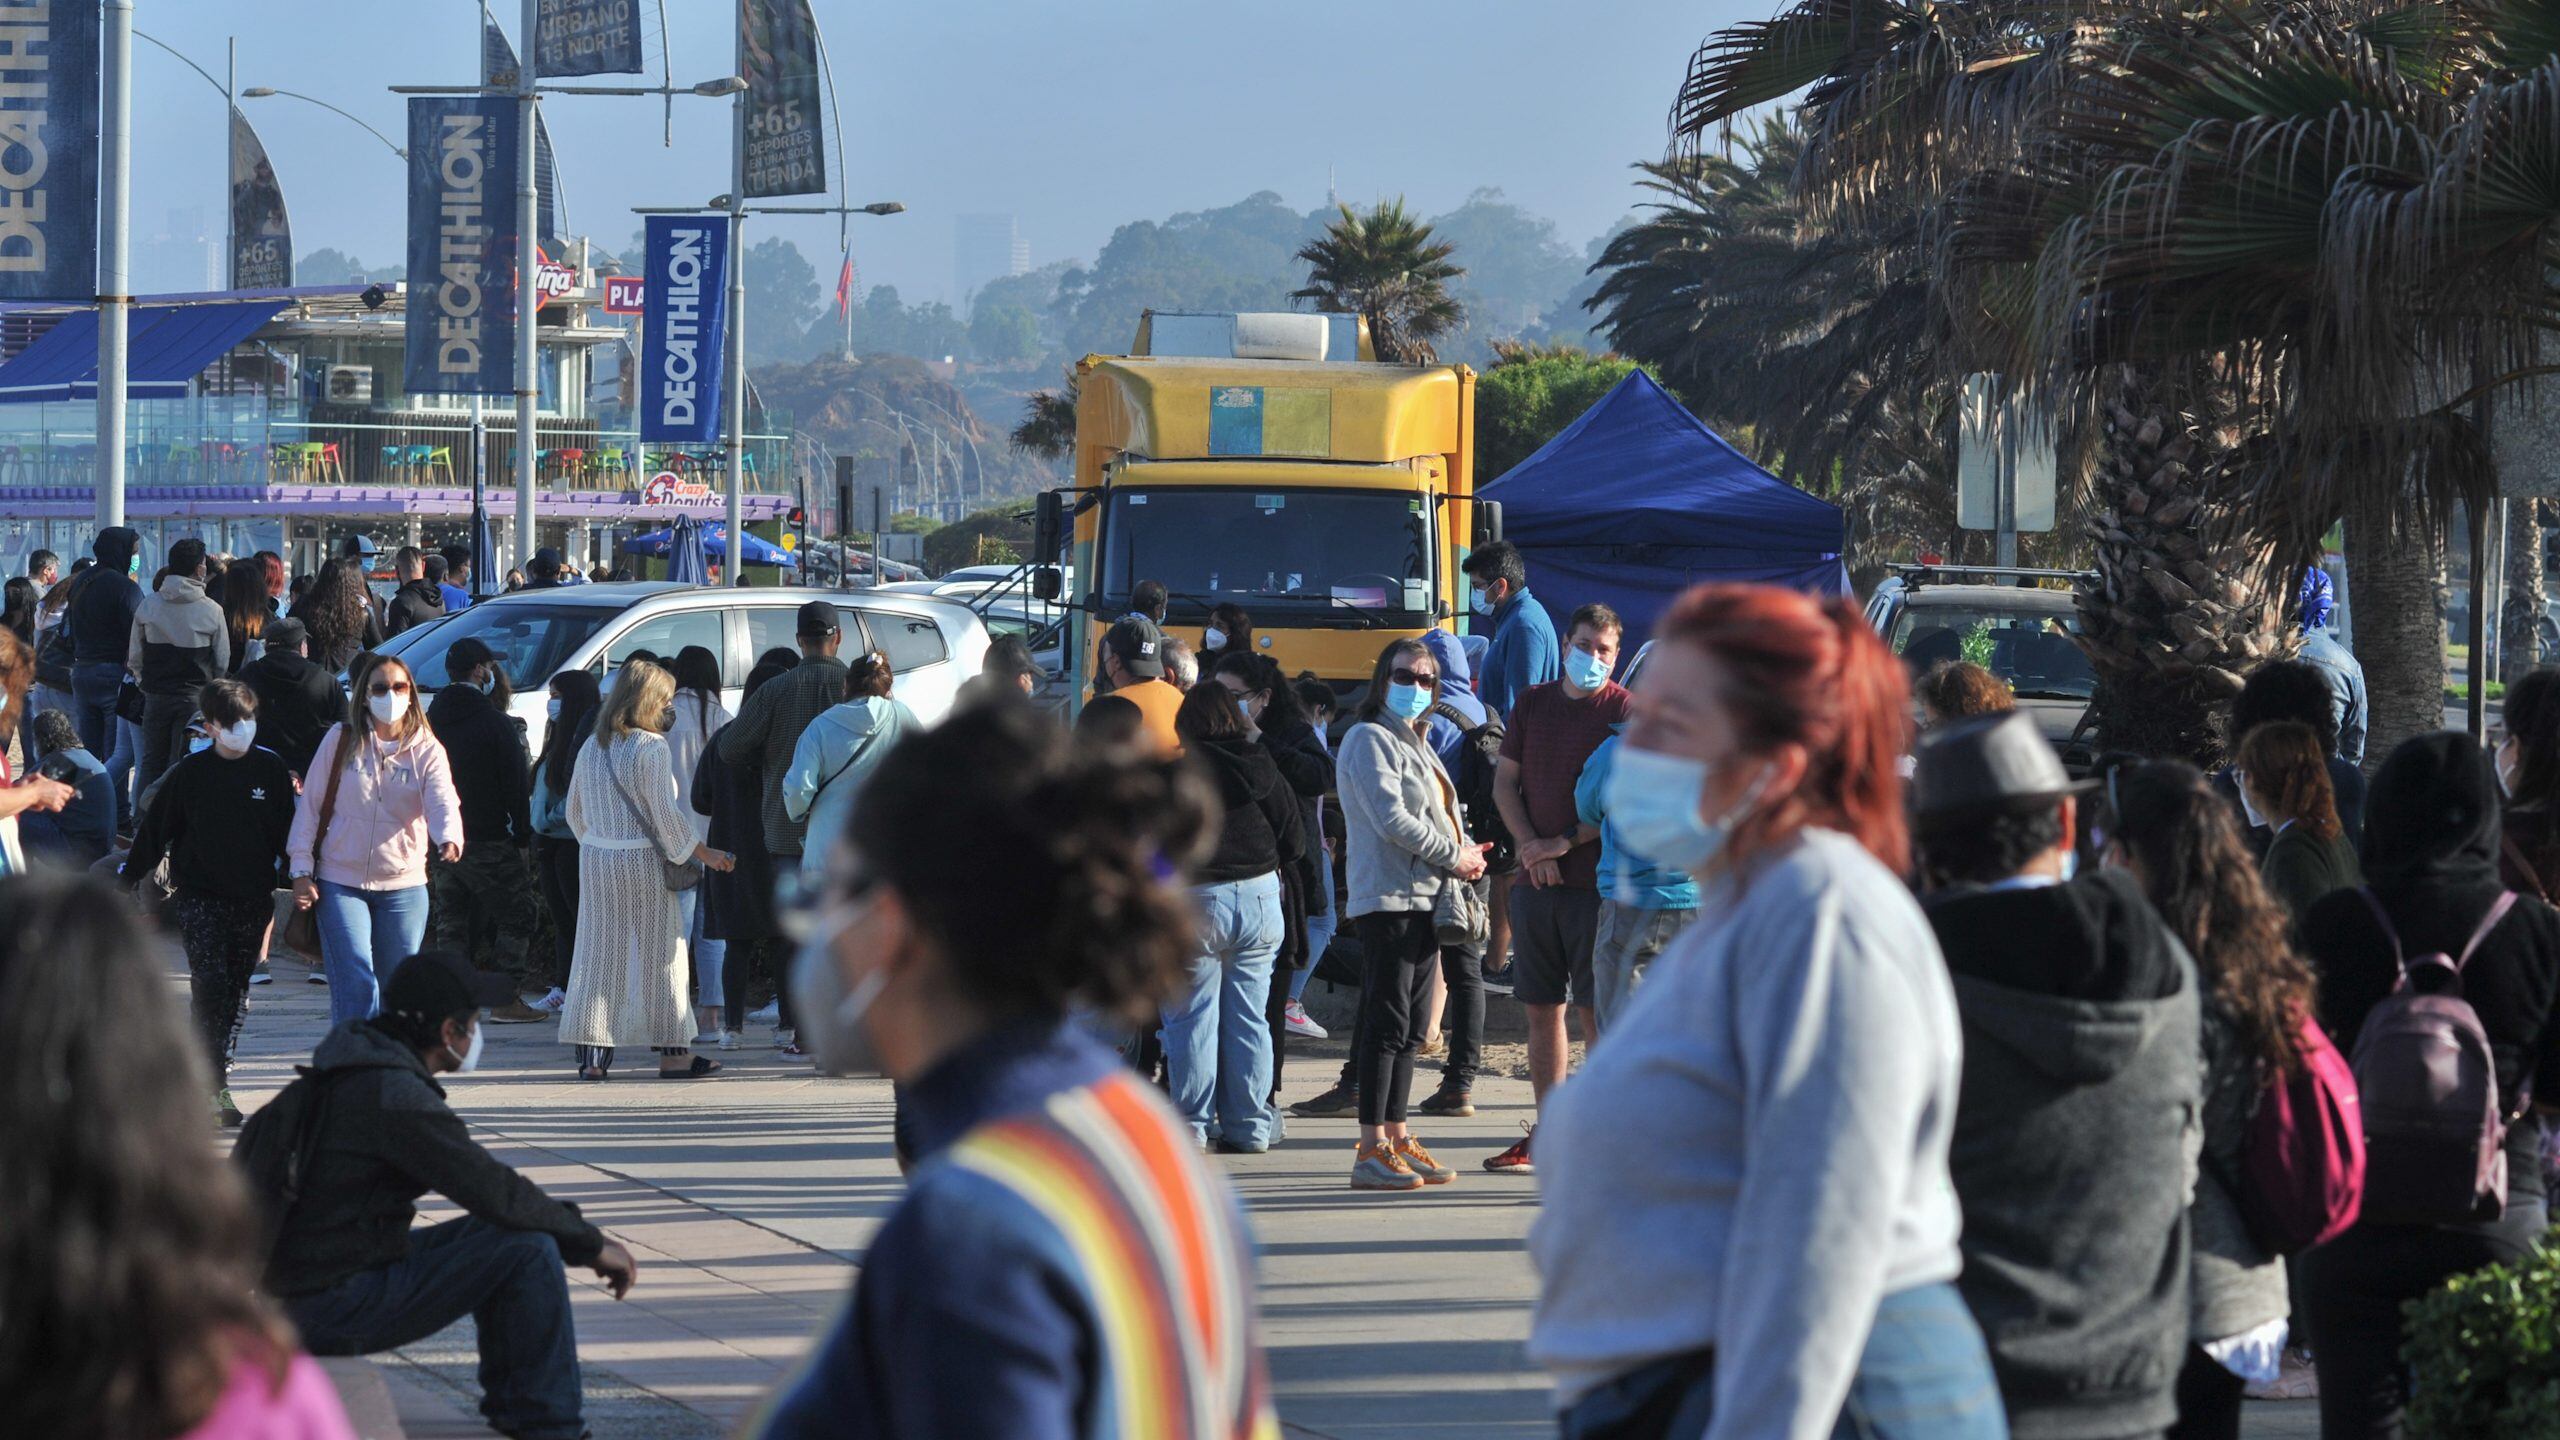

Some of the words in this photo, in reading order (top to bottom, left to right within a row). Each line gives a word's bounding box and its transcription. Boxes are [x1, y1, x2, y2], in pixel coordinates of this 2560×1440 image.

[541, 1, 630, 40] URBANO
[543, 42, 564, 63] 15
[568, 26, 630, 58] NORTE
[487, 116, 497, 133] Mar
[748, 99, 802, 138] +65
[0, 0, 49, 271] DECATHL
[487, 134, 496, 149] del
[749, 130, 813, 156] DEPORTES
[787, 145, 814, 161] SOLA
[749, 159, 817, 192] TIENDA
[239, 240, 277, 264] +65
[438, 115, 484, 373] DECATHLON
[703, 243, 711, 255] del
[663, 229, 702, 425] DECATHLON
[674, 480, 708, 497] Crazy
